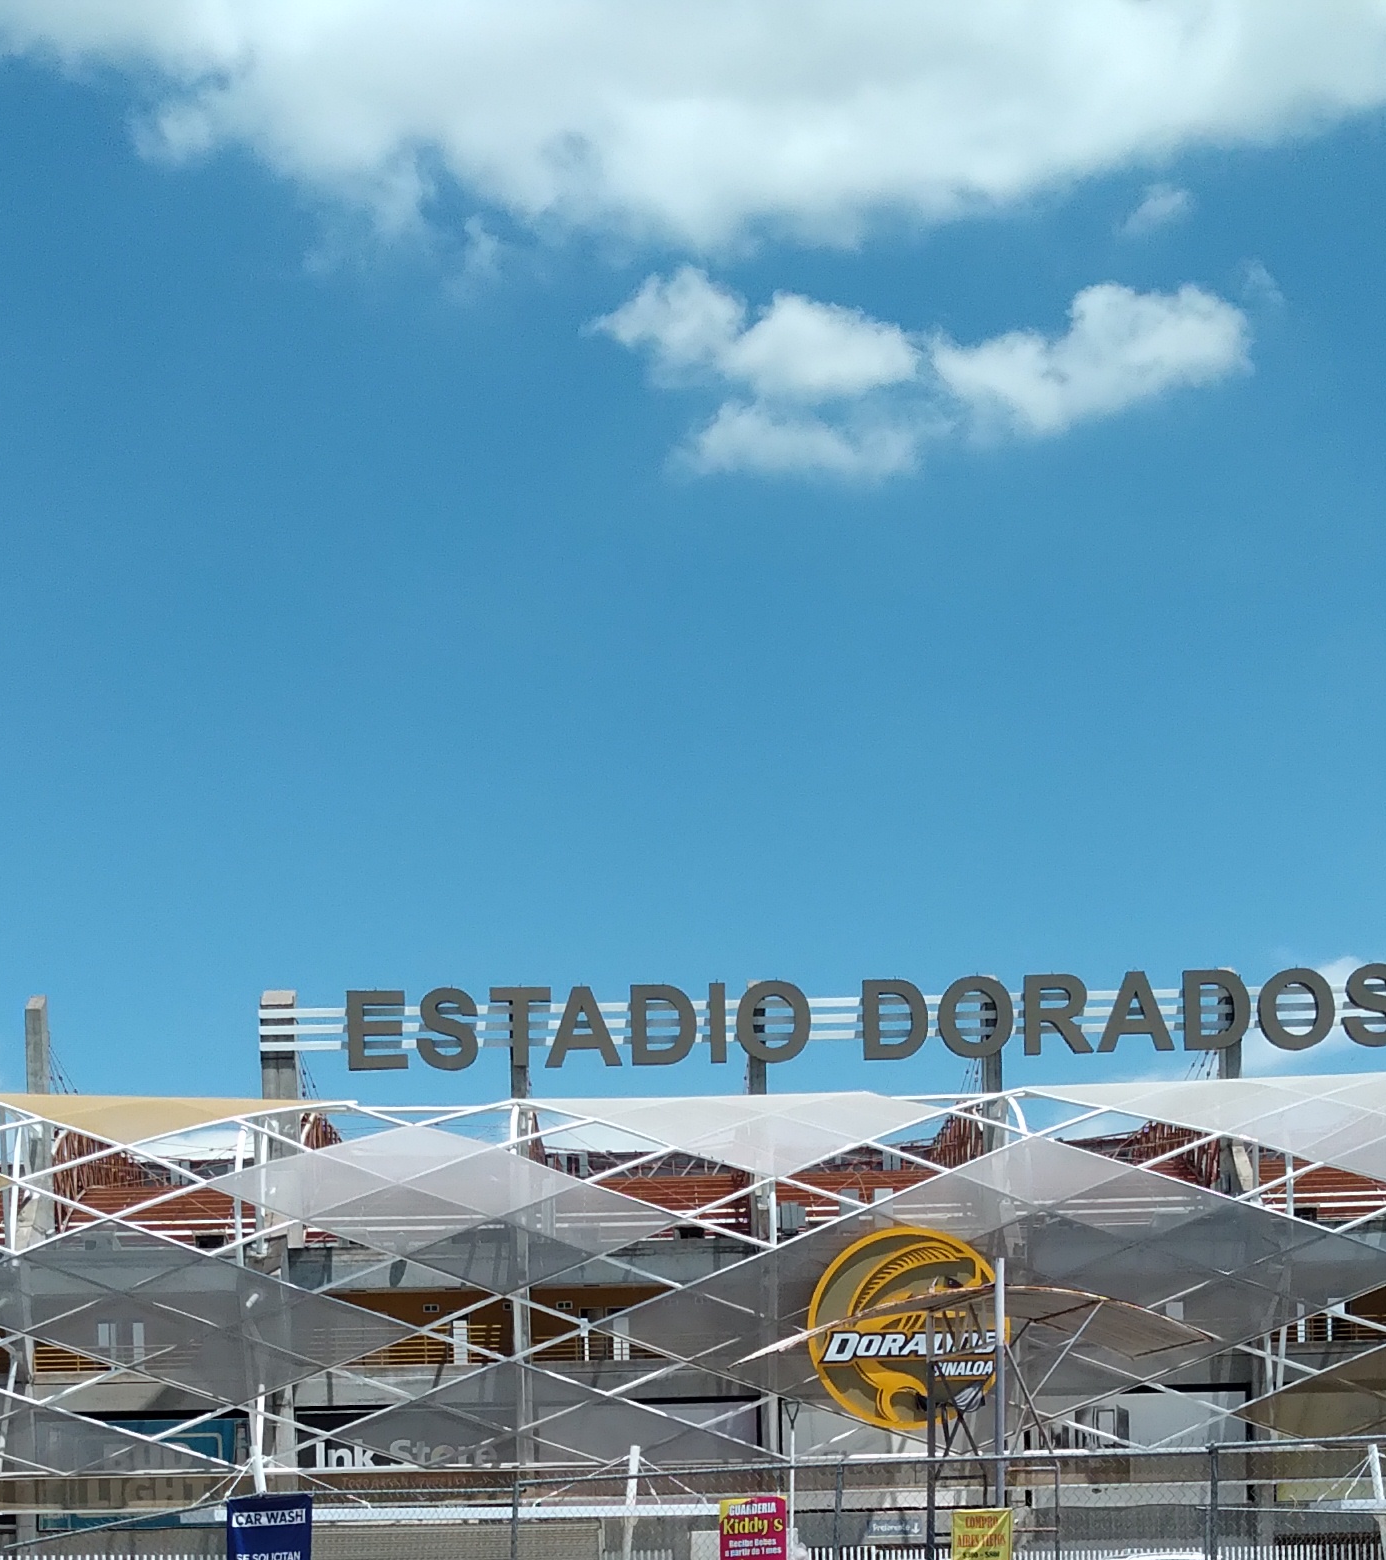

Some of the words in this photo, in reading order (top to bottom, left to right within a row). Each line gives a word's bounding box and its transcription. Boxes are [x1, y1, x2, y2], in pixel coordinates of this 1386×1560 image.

[346, 979, 812, 1071] ESTADIO
[823, 1331, 997, 1363] DORAS
[315, 1438, 375, 1469] Ink
[389, 1439, 499, 1468] Store
[235, 1513, 263, 1526] CAR
[265, 1510, 304, 1525] WASH
[729, 1502, 777, 1516] GUARDERIA
[965, 1515, 999, 1529] COMPRO
